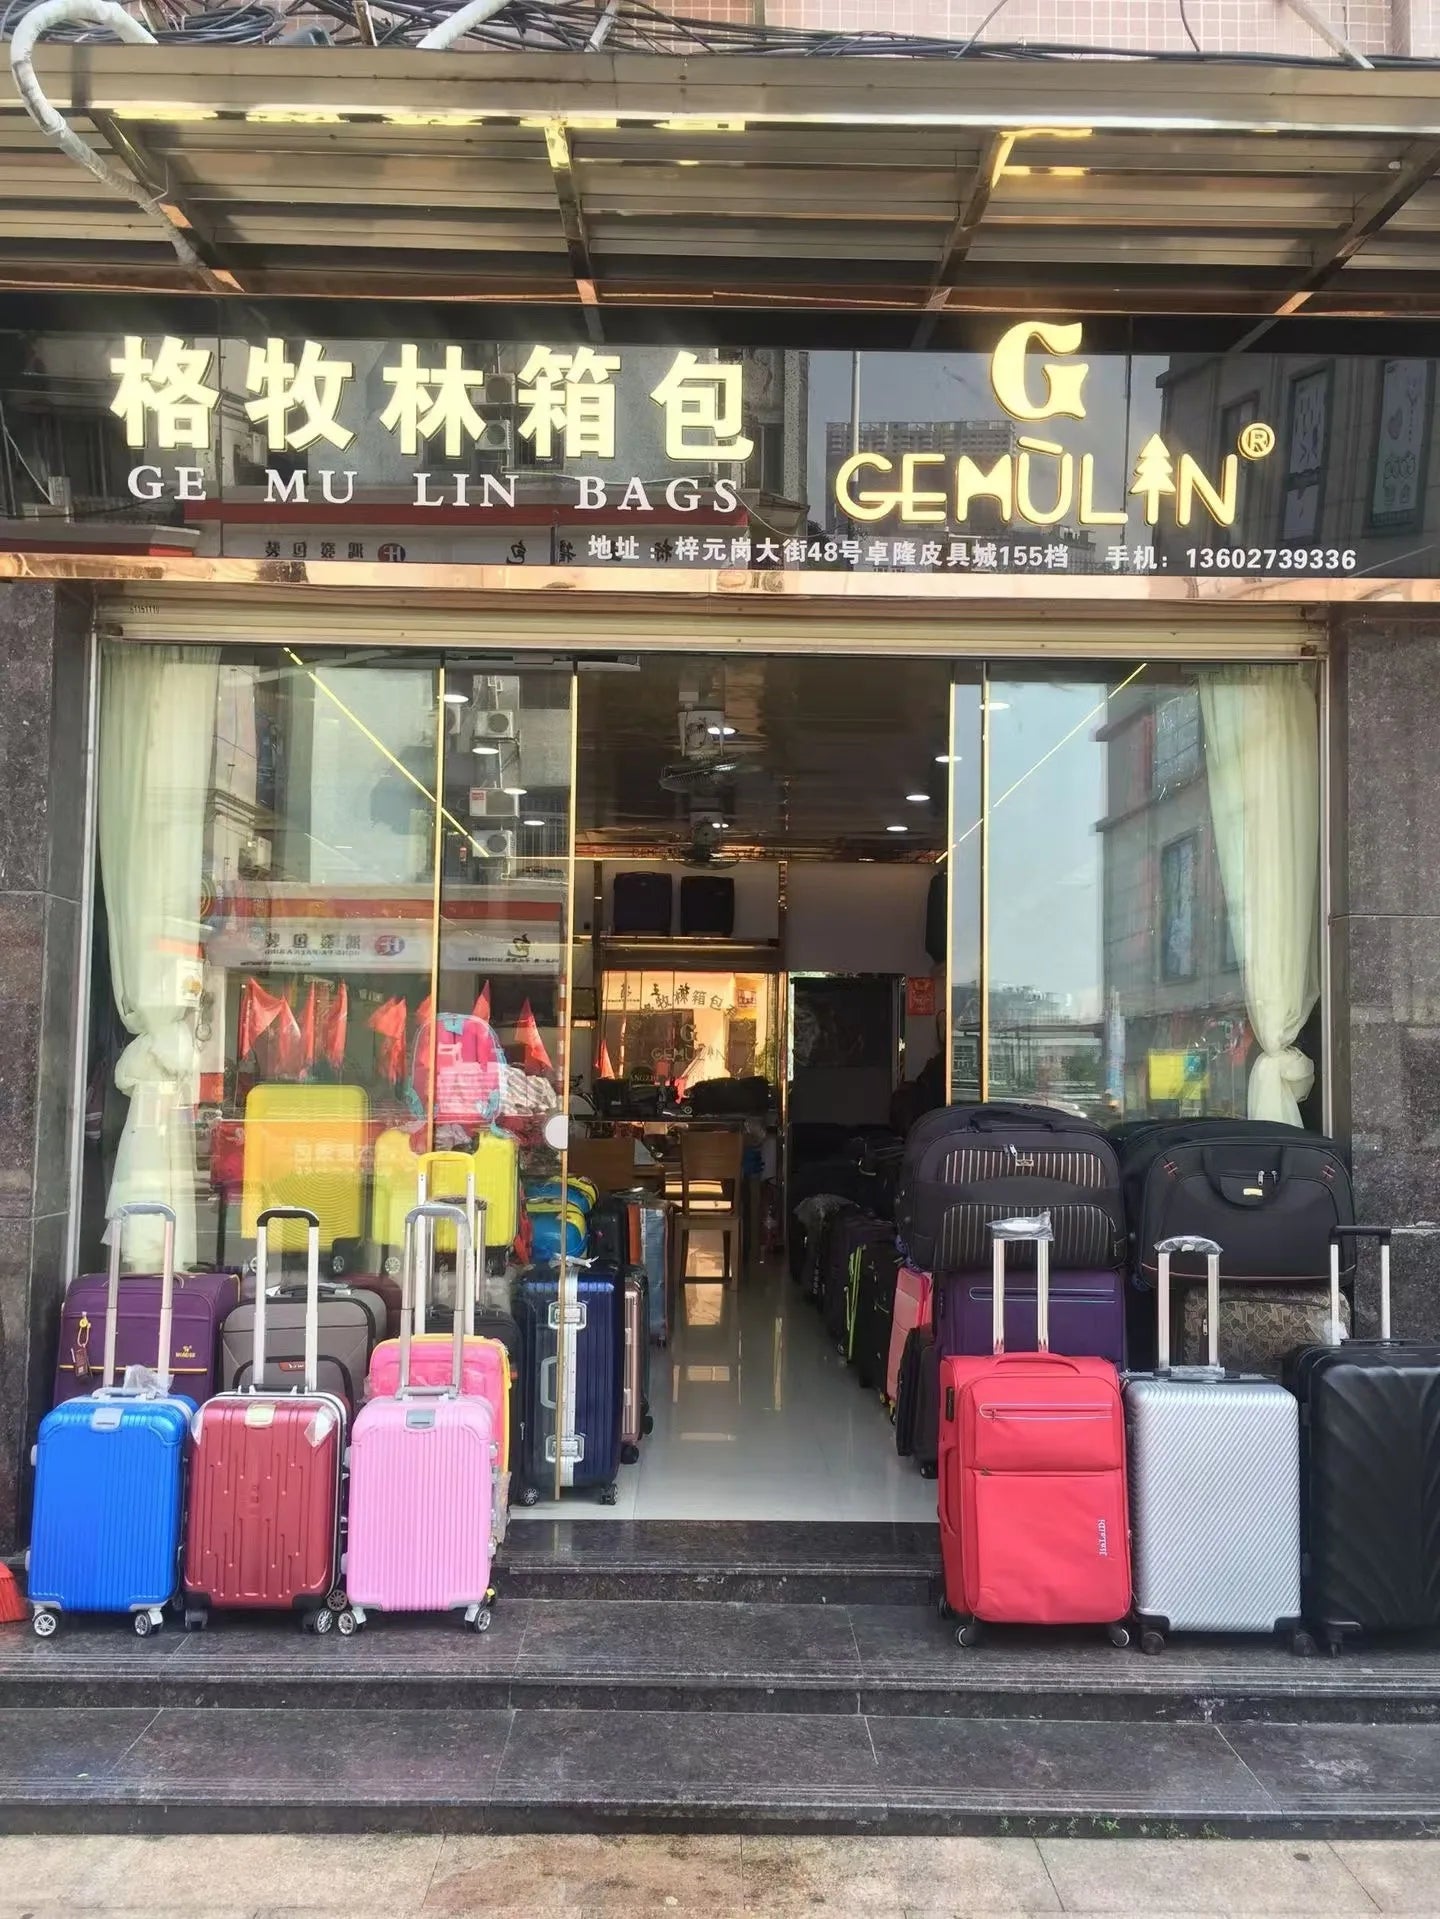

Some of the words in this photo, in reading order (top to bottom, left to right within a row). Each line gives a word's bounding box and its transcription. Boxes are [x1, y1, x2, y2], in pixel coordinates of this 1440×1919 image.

[109, 336, 754, 462] 格牧林箱包
[989, 321, 1090, 422] G
[126, 465, 207, 501] GE
[263, 469, 358, 504] MU
[412, 473, 519, 508] LIN
[574, 476, 739, 513] BAGS
